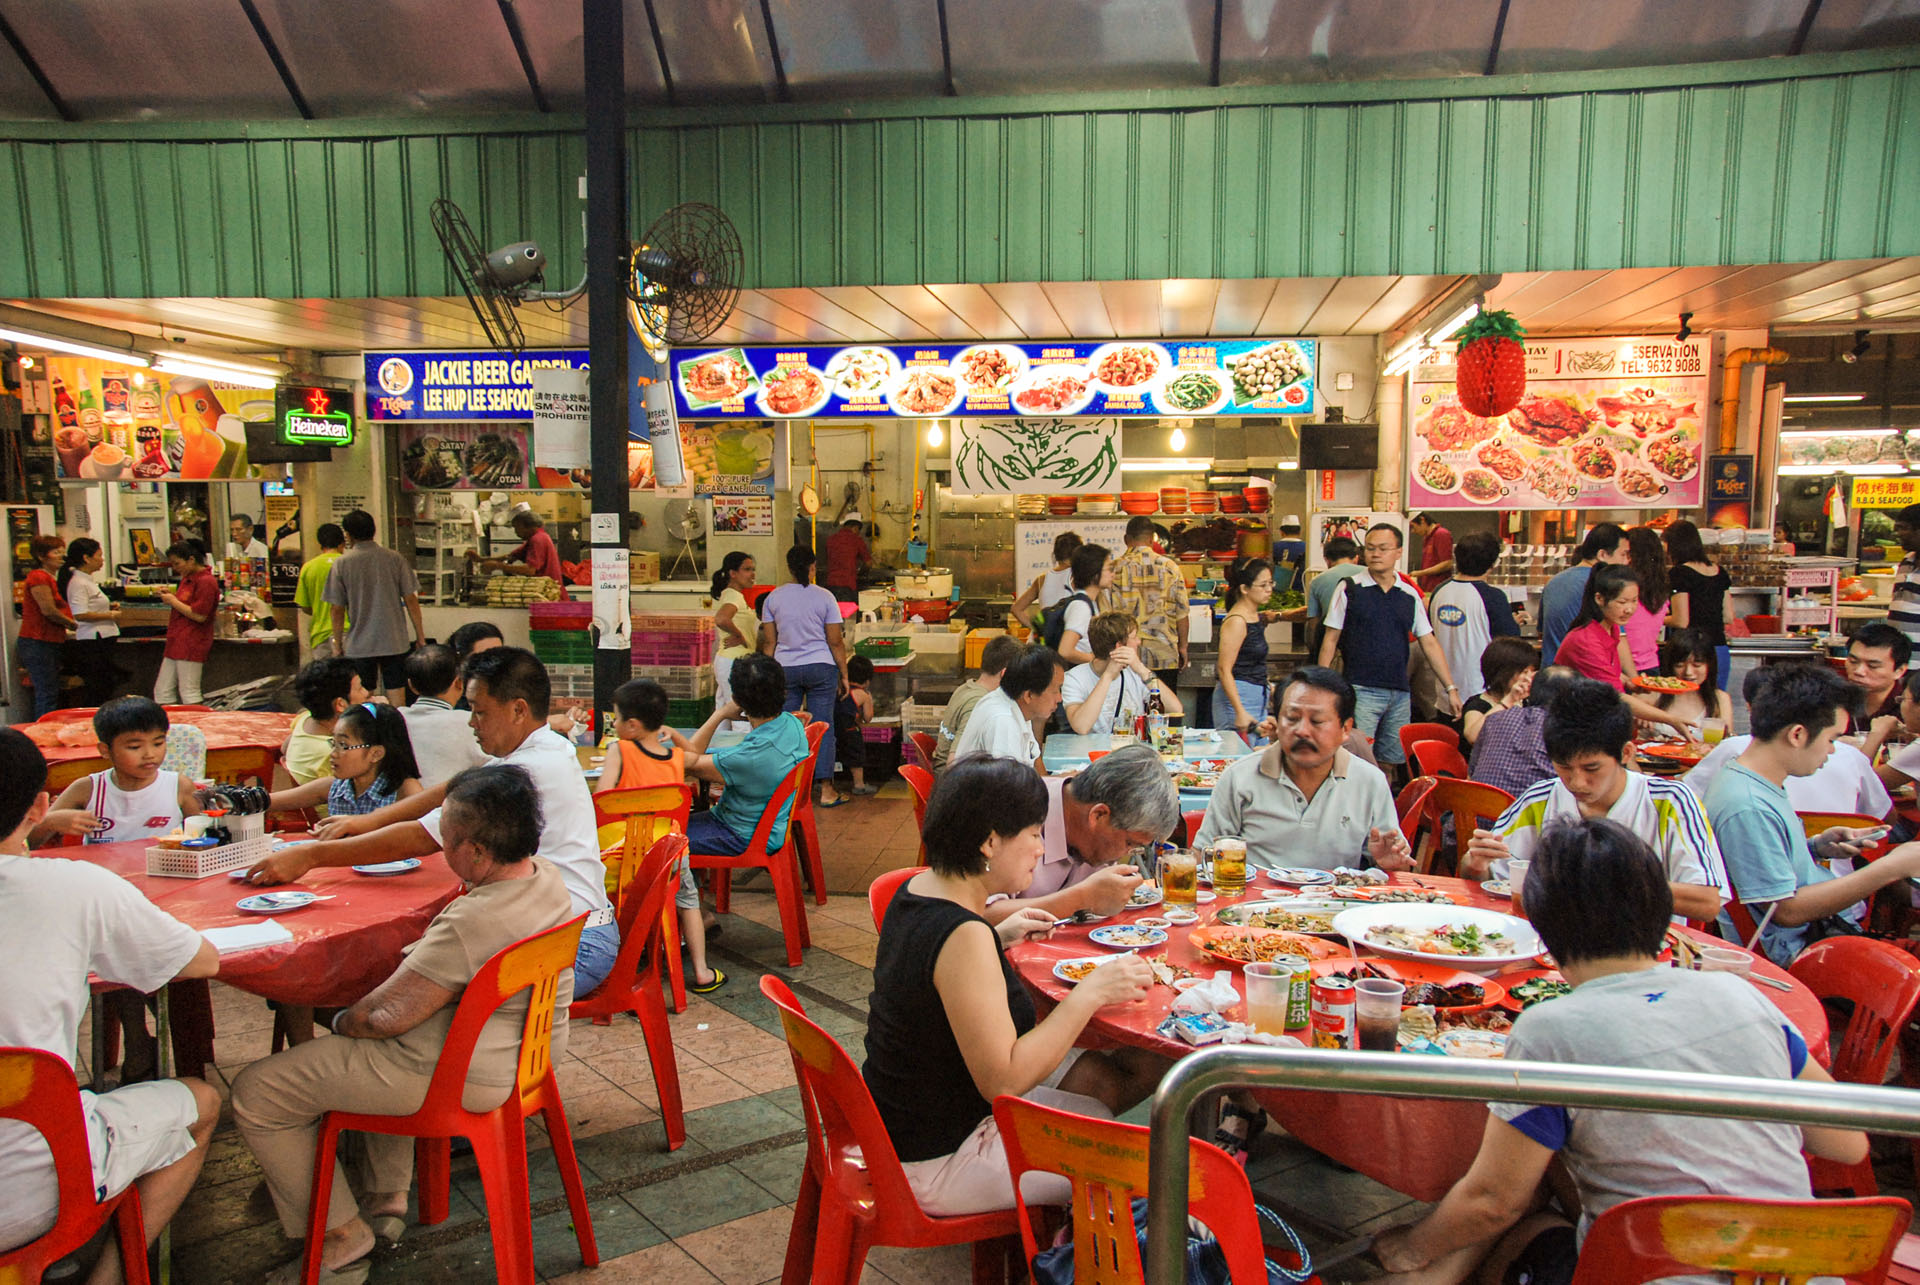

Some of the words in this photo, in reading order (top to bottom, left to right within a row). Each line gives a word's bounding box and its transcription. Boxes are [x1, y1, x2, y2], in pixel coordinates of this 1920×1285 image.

[1621, 361, 1644, 373] TEL:
[1647, 360, 1672, 373] 9632
[1675, 358, 1701, 372] 9088
[423, 359, 472, 386] JACKIE
[473, 360, 508, 386] BEER
[422, 388, 443, 412] LEE
[443, 388, 466, 411] HUP
[466, 388, 488, 412] LEE
[535, 392, 590, 402] 请勿在此处吸
[379, 397, 415, 415] Tiger
[535, 412, 590, 420] PROHIBITE
[289, 416, 348, 437] Heineken
[439, 441, 465, 450] SATAY
[499, 475, 521, 484] OTAH
[1716, 479, 1746, 495] Tiger
[1856, 481, 1914, 494] 燒烤海鮮
[272, 566, 279, 576] $
[1440, 609, 1463, 620] SURF
